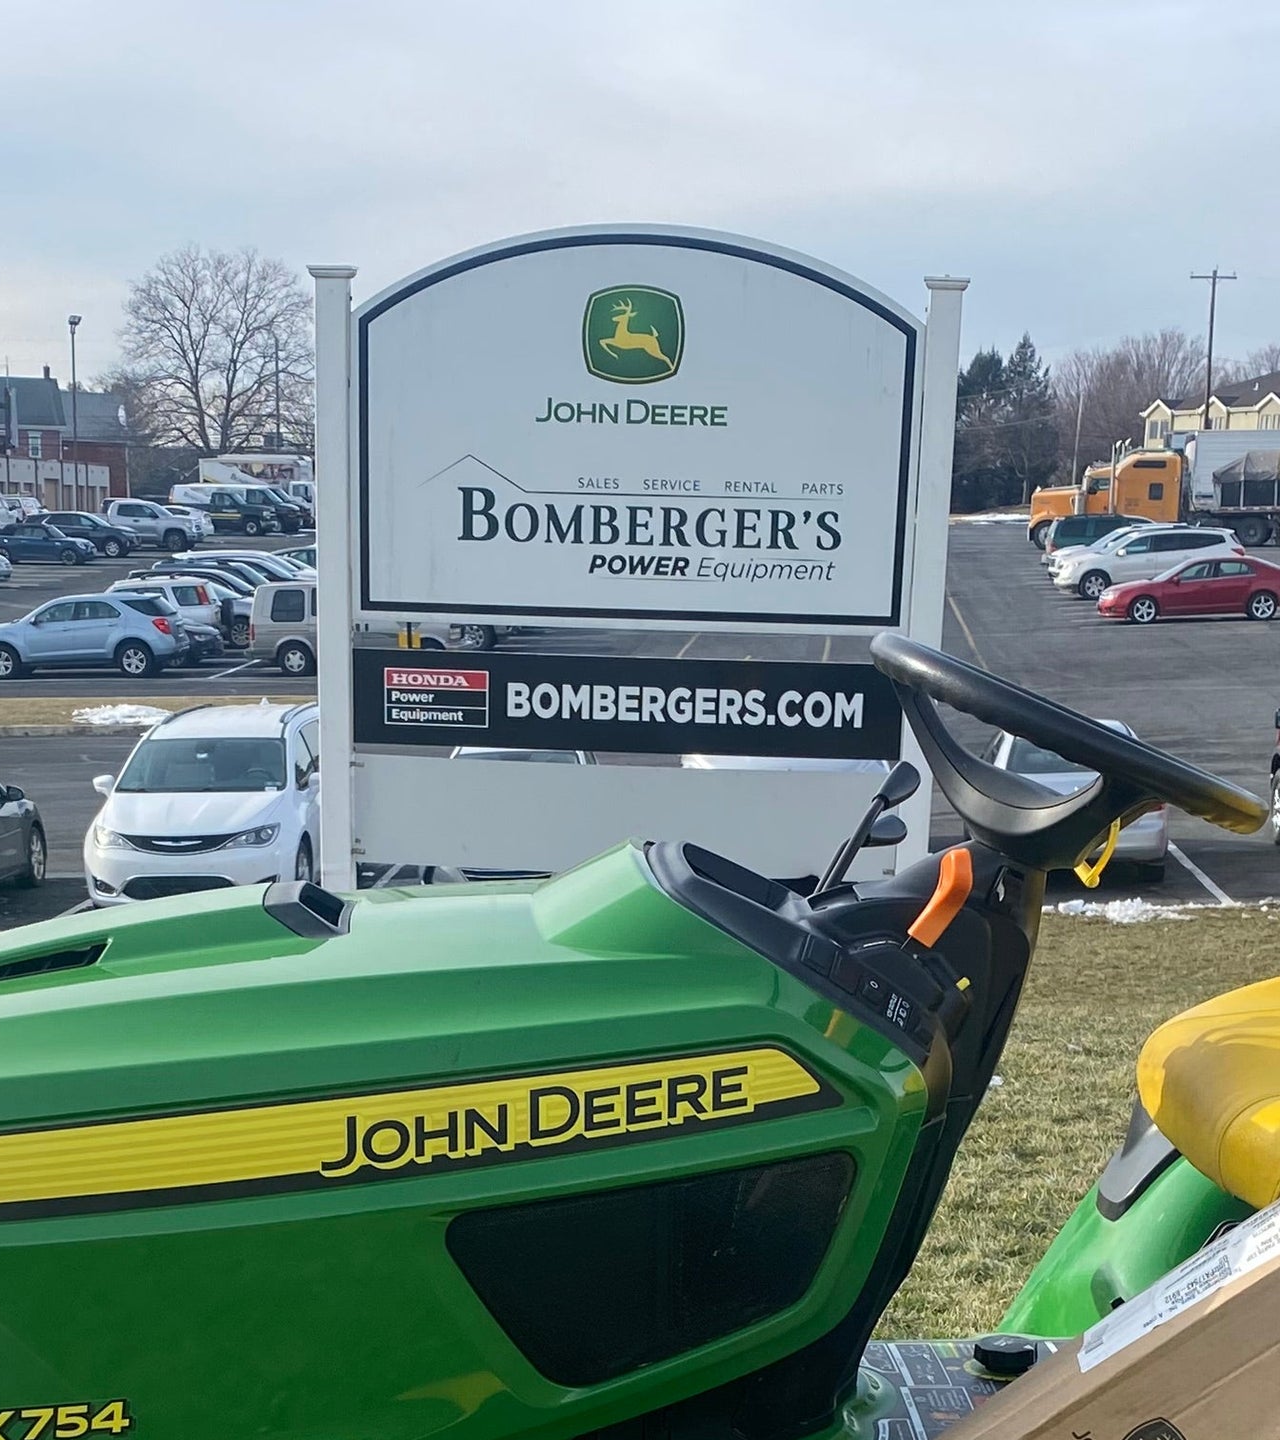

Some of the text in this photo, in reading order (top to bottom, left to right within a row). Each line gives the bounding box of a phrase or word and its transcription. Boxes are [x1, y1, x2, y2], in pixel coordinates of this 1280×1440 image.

[535, 397, 728, 427] JOHN DEERE
[577, 477, 844, 496] SALES SERVICE RENTAL PARTS
[457, 486, 842, 551] BOMBERGER'S
[588, 554, 837, 583] POWER Equipment
[391, 673, 470, 687] HONDA
[391, 690, 434, 702] Power
[507, 682, 864, 729] BOMBERGERS.COM
[391, 708, 464, 721] Equipment
[319, 1065, 752, 1177] JOHN DEERE
